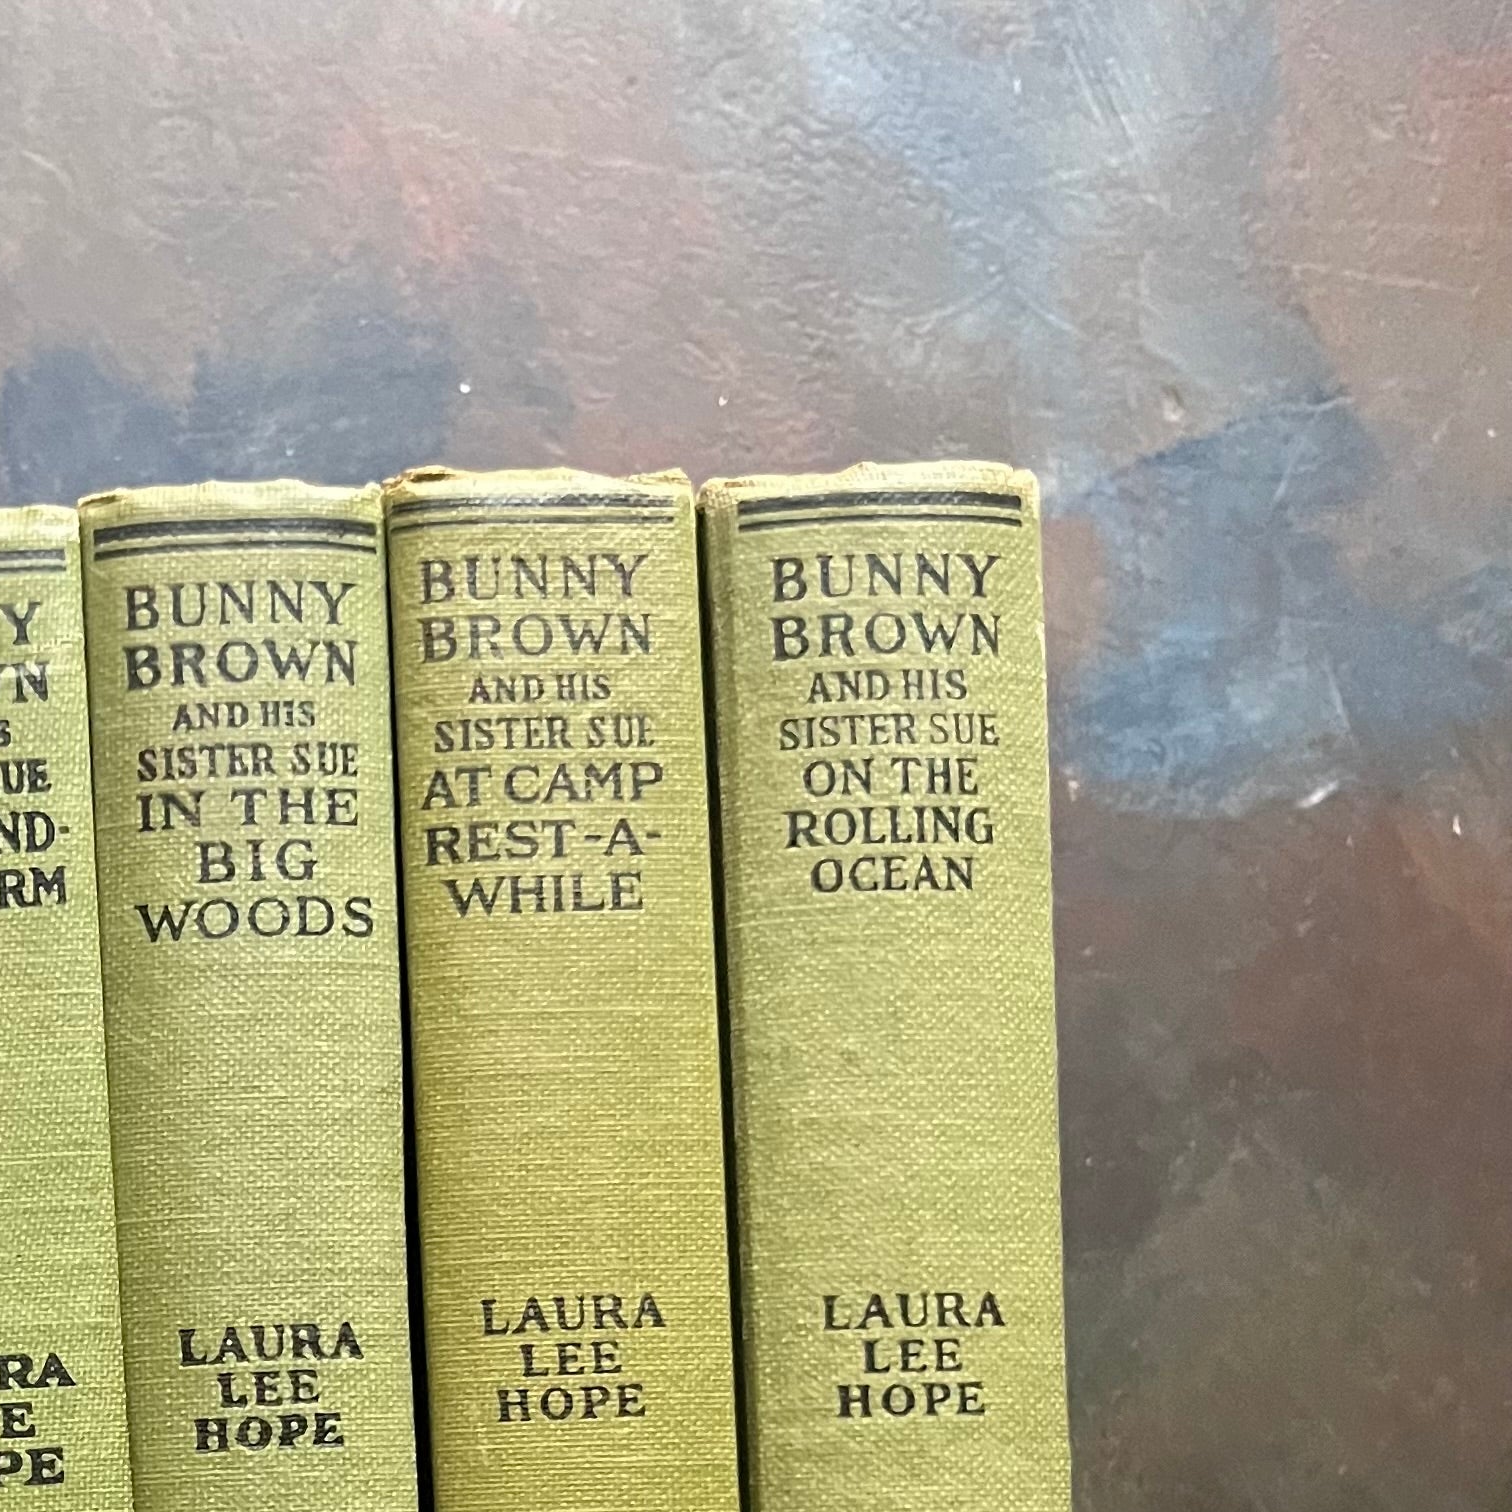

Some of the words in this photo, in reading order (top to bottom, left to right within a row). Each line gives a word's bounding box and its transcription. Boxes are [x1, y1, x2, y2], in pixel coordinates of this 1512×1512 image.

[419, 553, 650, 604] BUNNY
[771, 553, 1002, 603] BUNNY
[126, 580, 357, 631] BUNNY
[418, 612, 653, 664] BROWN
[770, 613, 1001, 662] BROWN
[124, 639, 358, 691] BROWN
[808, 671, 889, 702] AND
[902, 669, 967, 700] HIS
[469, 675, 544, 704] AND
[556, 673, 611, 699] HIS
[172, 704, 249, 731] AND
[261, 700, 315, 728] HIS
[435, 717, 574, 754] SISTER
[588, 714, 654, 749] SUE
[779, 714, 917, 751] SISTER
[930, 712, 1000, 746] SUE
[137, 745, 277, 783] SISTER
[292, 743, 359, 778] SUE
[802, 760, 873, 798] ON
[891, 757, 978, 795] THE
[422, 766, 492, 811] AT
[504, 761, 664, 803] CAMP
[137, 791, 204, 832] IN
[230, 788, 360, 827] THE
[787, 806, 993, 850] ROLLING
[195, 839, 319, 884] BIG
[425, 818, 662, 866] REST-A-
[441, 871, 644, 918] WHILE
[811, 857, 975, 893] OCEAN
[135, 896, 374, 943] WOODS
[480, 1293, 668, 1336] LAURA
[822, 1291, 1005, 1333] LAURA
[179, 1321, 365, 1368] LAURA
[521, 1341, 623, 1378] LEE
[863, 1338, 963, 1377] LEE
[218, 1369, 321, 1410] LEE
[497, 1384, 647, 1425] HOPE
[837, 1383, 986, 1420] HOPE
[195, 1413, 345, 1455] HOPE
